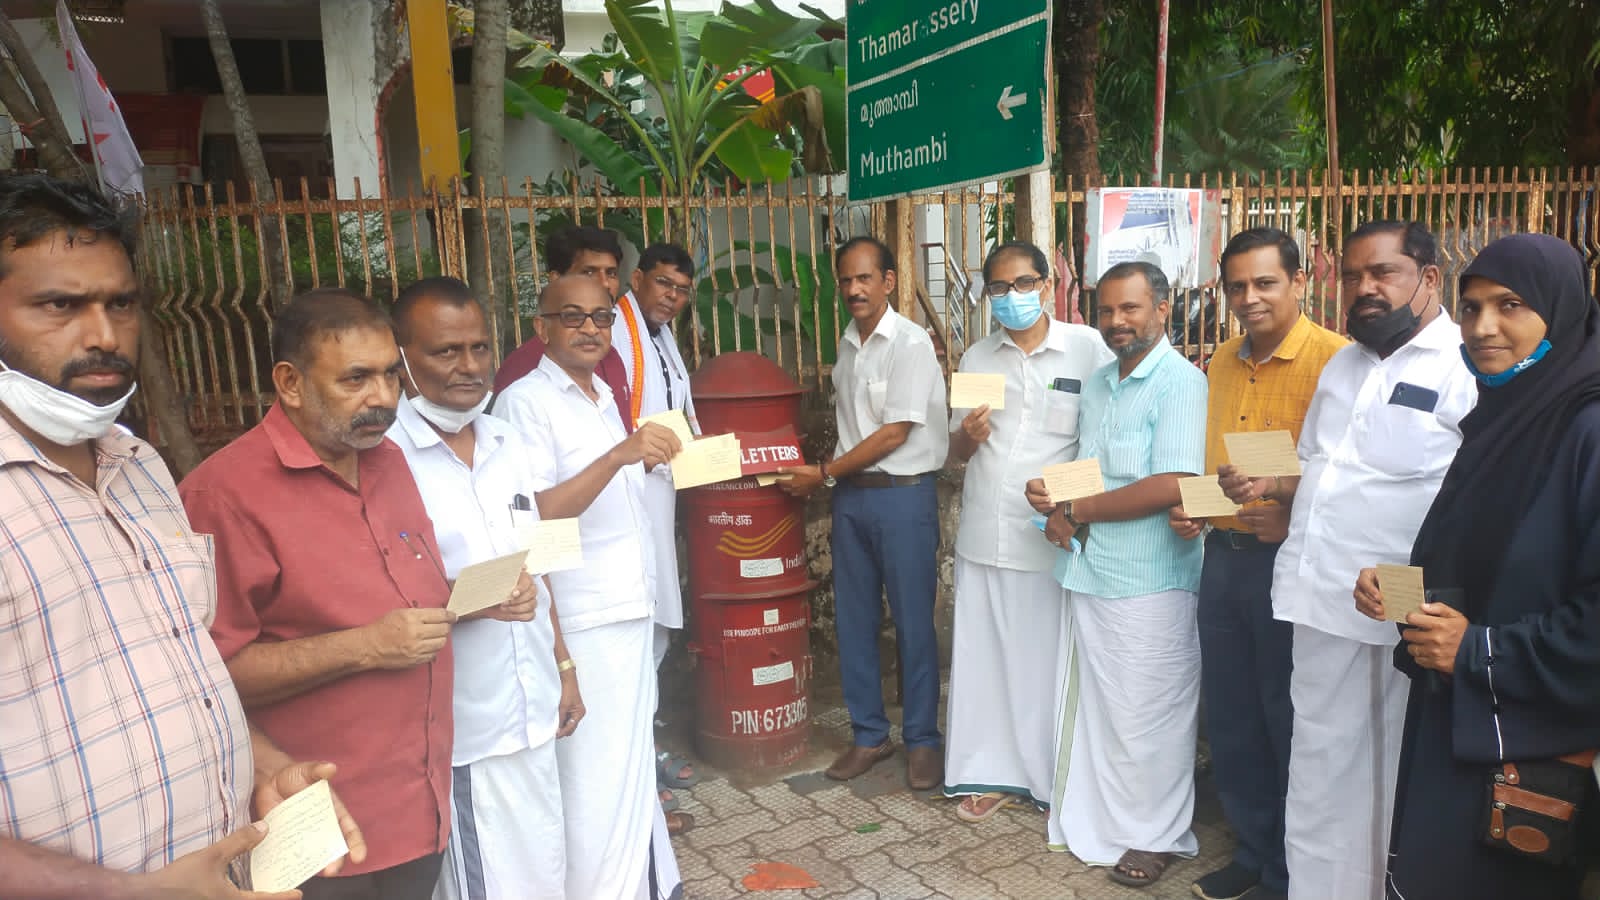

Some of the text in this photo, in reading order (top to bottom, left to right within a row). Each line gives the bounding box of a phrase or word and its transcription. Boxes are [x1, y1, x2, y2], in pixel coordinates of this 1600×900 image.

[860, 131, 947, 178] Muthambi
[741, 445, 799, 465] LETTERS
[735, 514, 753, 527] डाक
